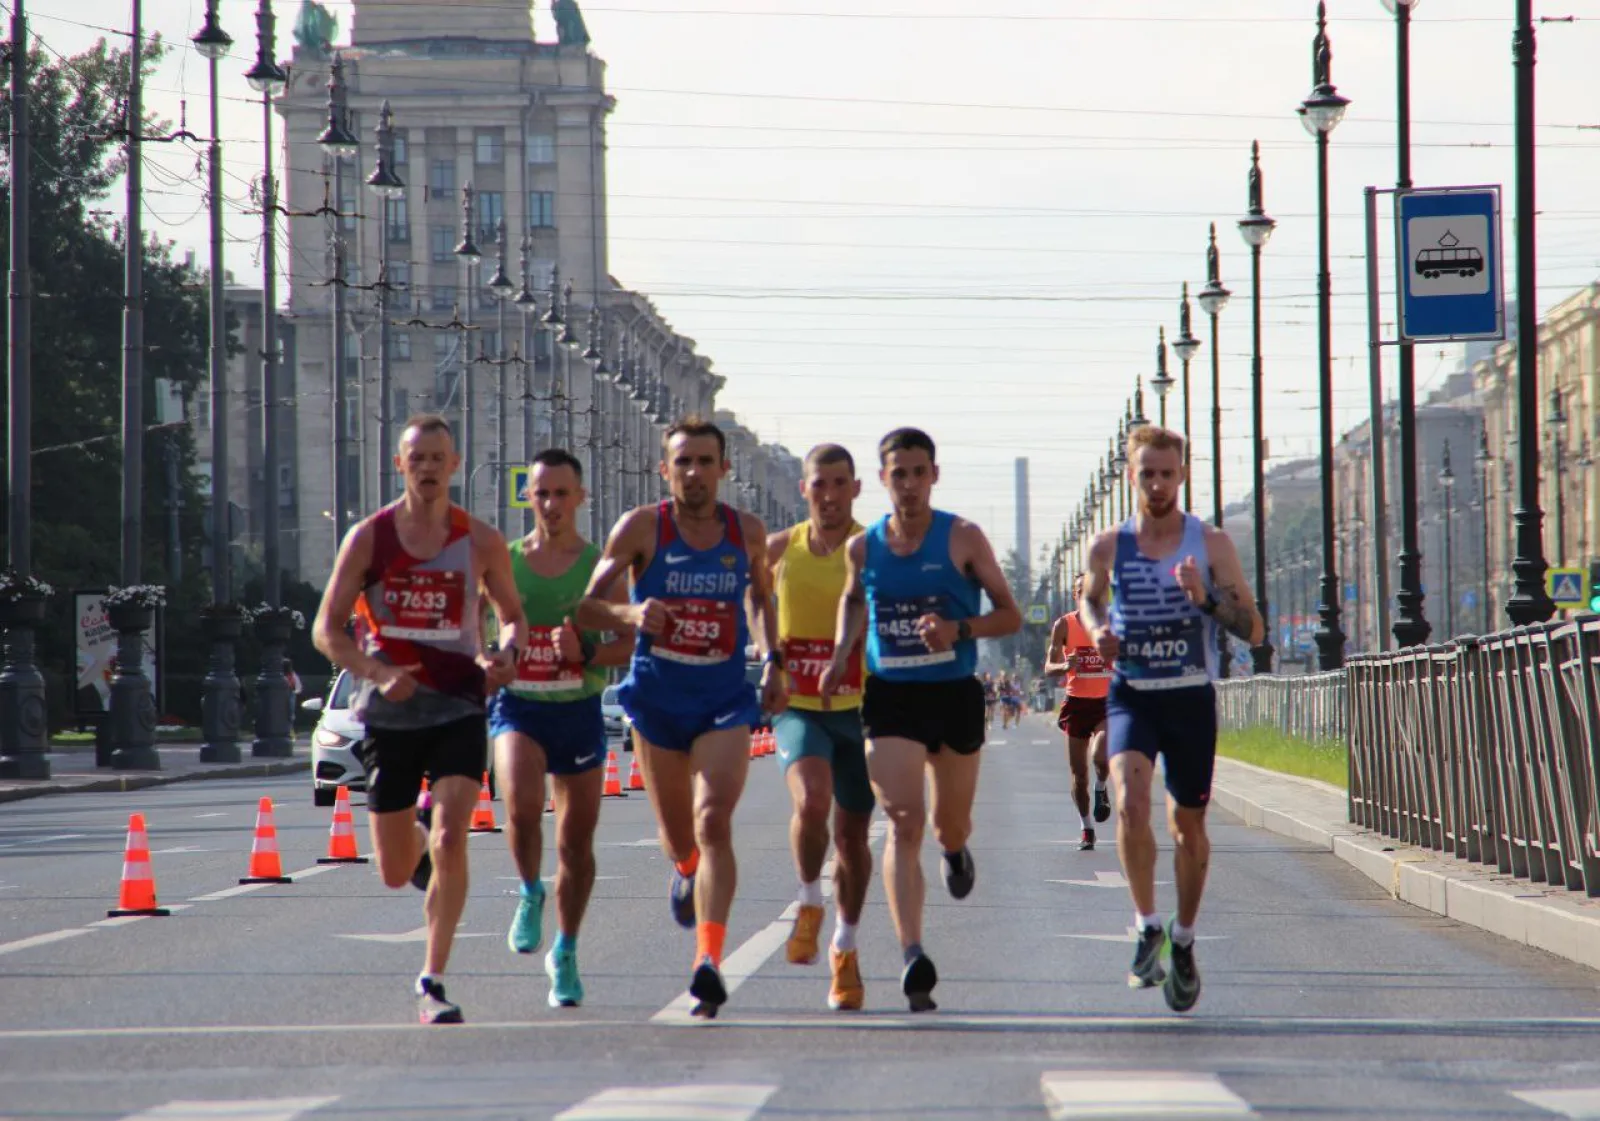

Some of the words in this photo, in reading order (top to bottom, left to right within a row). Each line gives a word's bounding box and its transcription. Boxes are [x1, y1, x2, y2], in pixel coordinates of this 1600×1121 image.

[665, 570, 738, 594] RUSSIA
[400, 590, 447, 610] 7633
[674, 619, 720, 639] 7533
[889, 619, 921, 636] 452
[522, 646, 562, 662] 748
[1140, 639, 1188, 658] 4470
